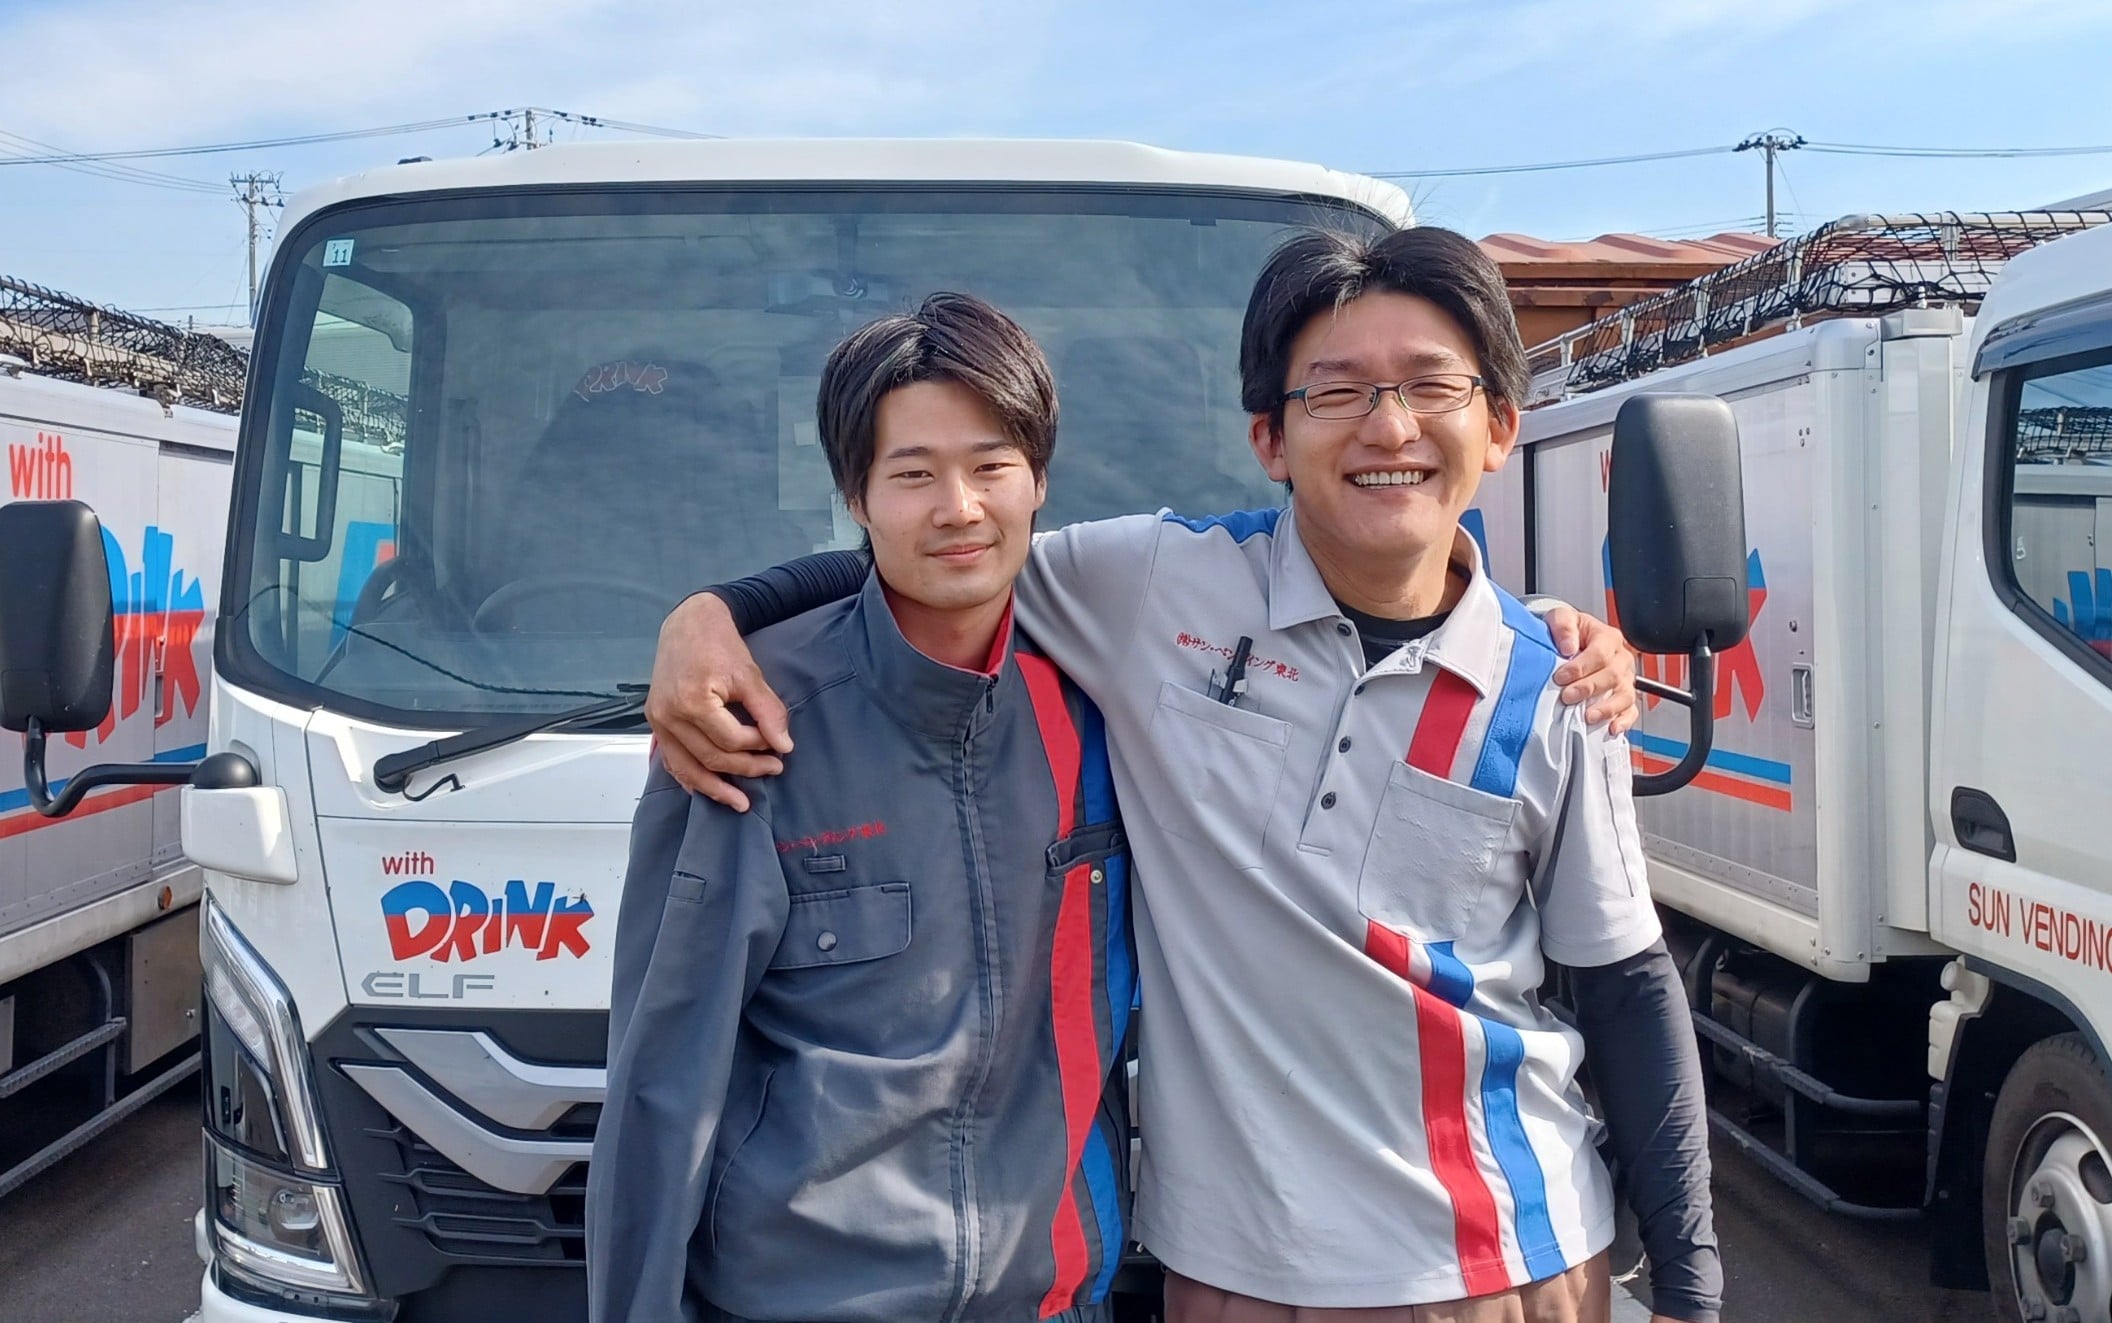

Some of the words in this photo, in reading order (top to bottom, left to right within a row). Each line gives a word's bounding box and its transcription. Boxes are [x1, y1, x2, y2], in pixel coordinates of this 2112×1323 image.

[332, 248, 347, 264] 11
[8, 432, 74, 499] with
[382, 851, 435, 875] with
[381, 880, 595, 962] DRINK
[1968, 882, 2010, 937] SUN
[361, 972, 495, 998] ELF
